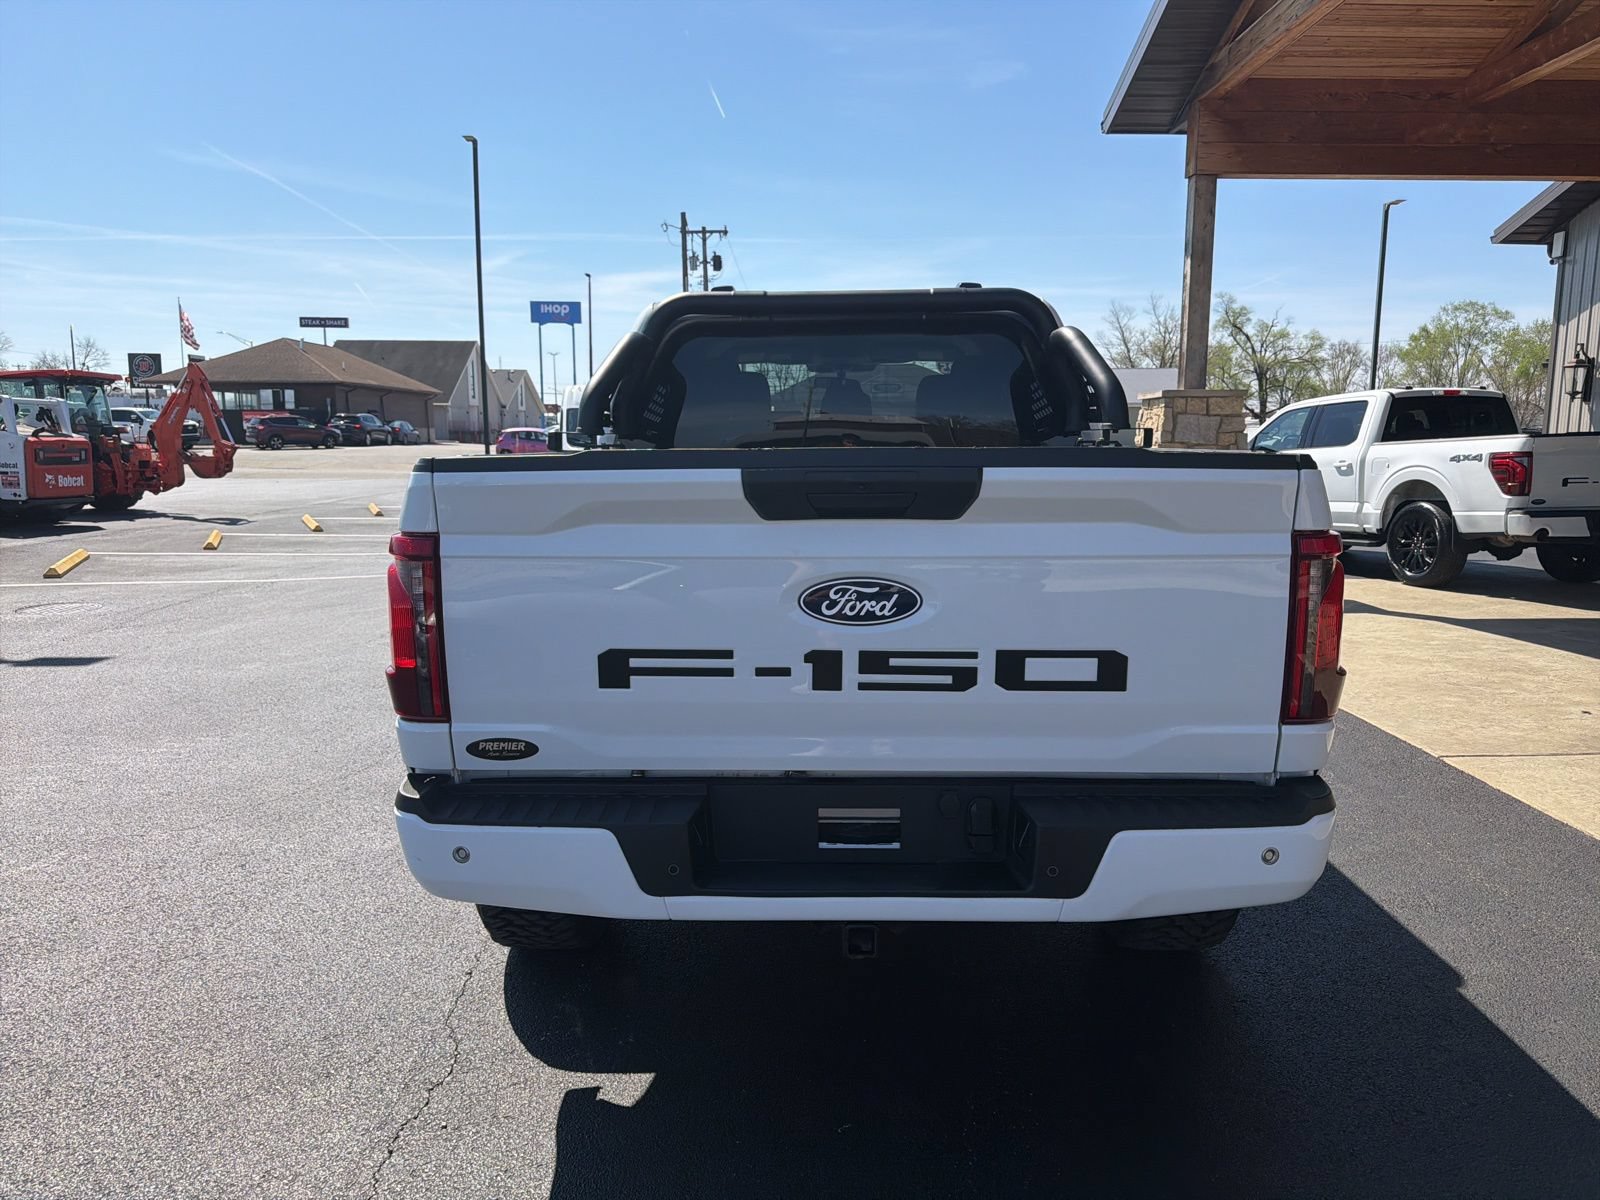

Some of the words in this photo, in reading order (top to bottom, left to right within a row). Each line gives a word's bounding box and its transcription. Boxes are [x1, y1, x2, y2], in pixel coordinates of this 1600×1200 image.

[58, 474, 84, 487] Bobcat
[821, 585, 898, 616] Ford
[597, 648, 1128, 692] F-150
[478, 741, 526, 751] PREMIER
